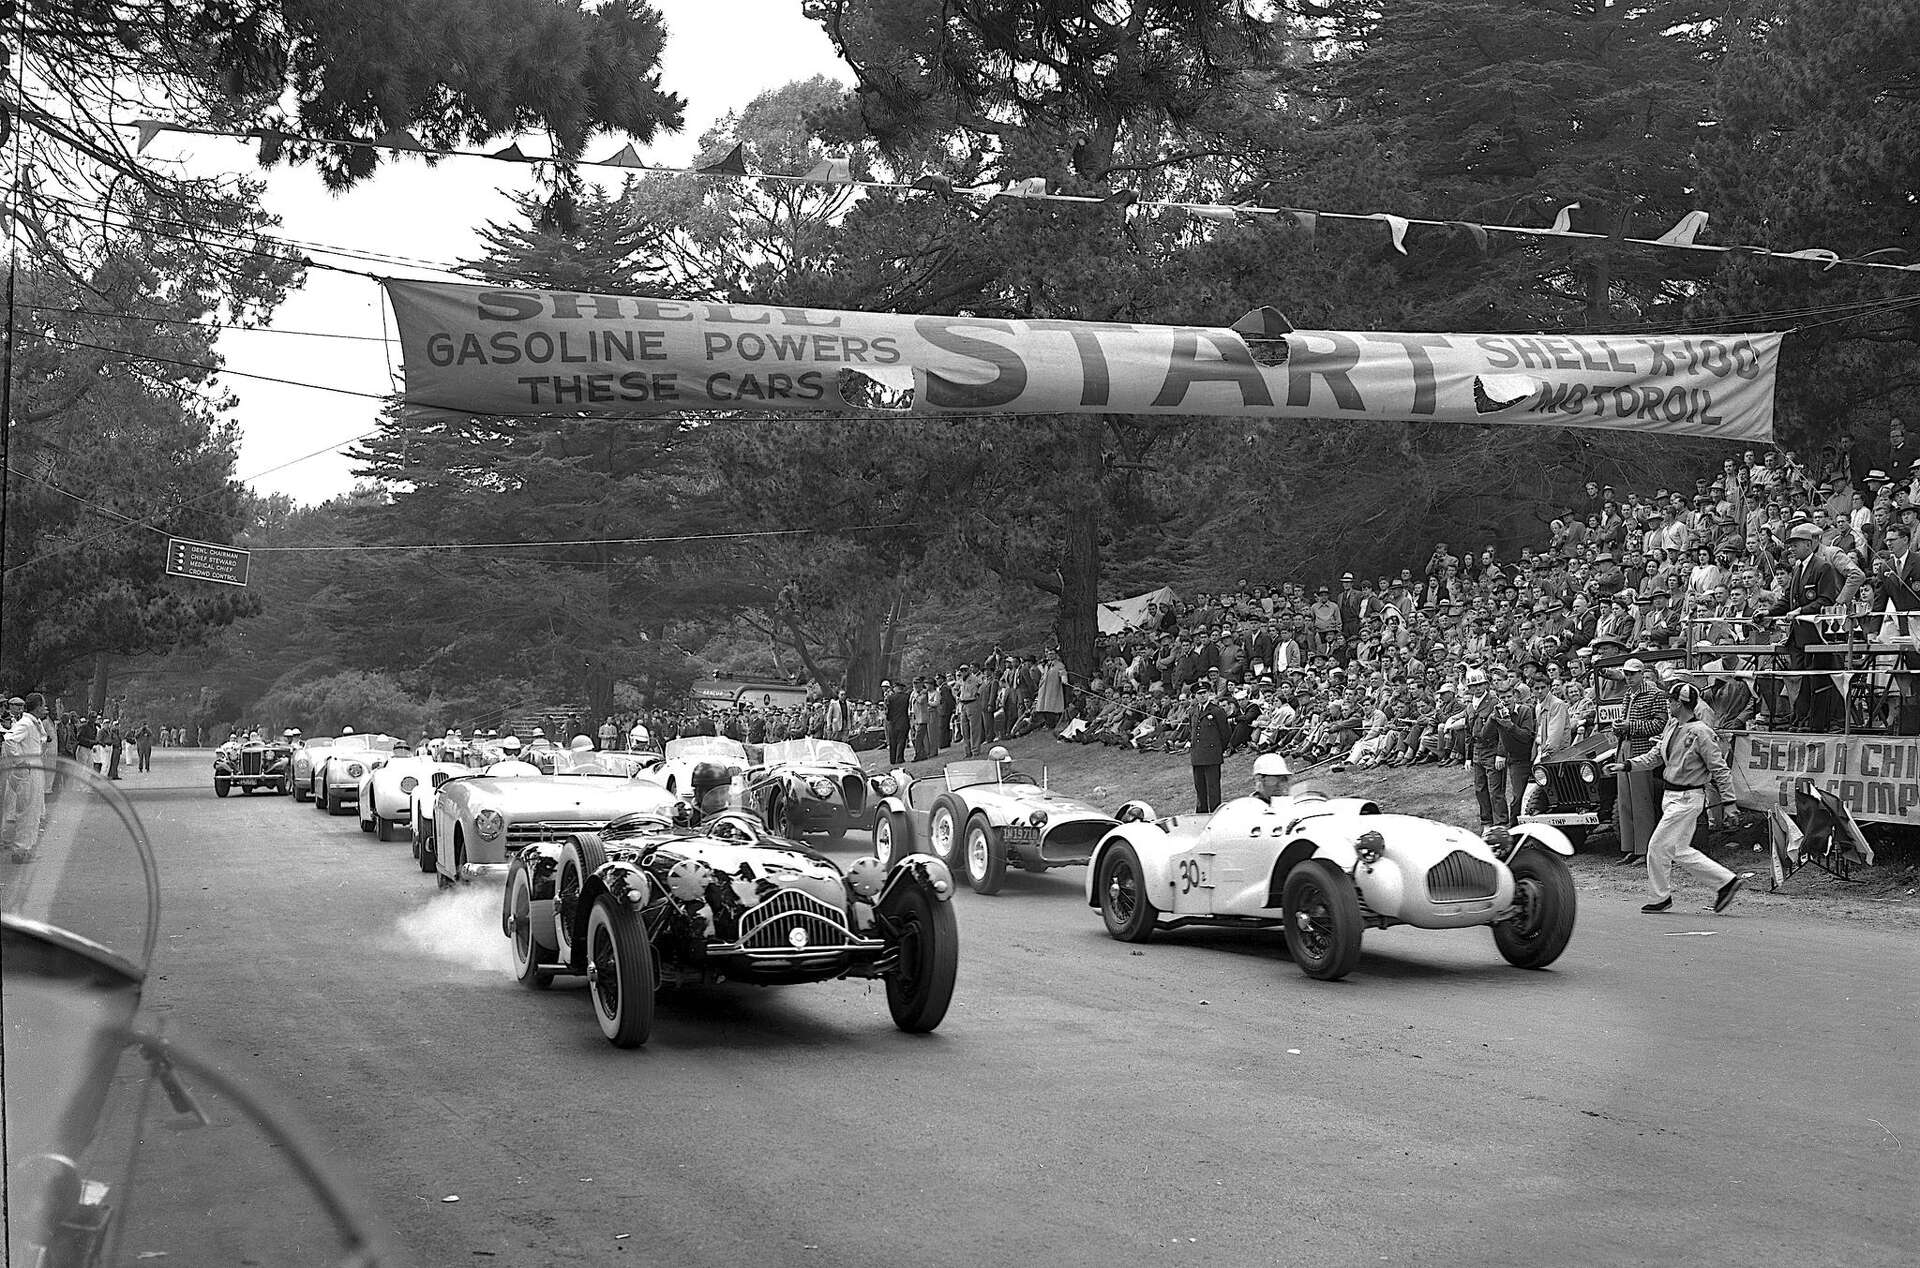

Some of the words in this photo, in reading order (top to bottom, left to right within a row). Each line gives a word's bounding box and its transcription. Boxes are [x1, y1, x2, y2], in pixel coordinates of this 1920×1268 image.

[478, 290, 841, 328] SHELL
[426, 330, 668, 367] GASOLINE
[705, 331, 902, 365] POWERS
[913, 316, 1453, 414] START
[1476, 337, 1636, 374] SHELL
[1636, 337, 1760, 380] X-100
[518, 371, 680, 405] THESE
[706, 372, 825, 402] CARS
[190, 561, 215, 569] MEDICAL
[209, 549, 239, 559] CHAIRMAN
[209, 557, 237, 566] STEWARD
[188, 568, 211, 577] CROWD
[212, 572, 238, 581] CONTROL
[1749, 739, 1825, 773] SEND
[1833, 743, 1848, 775] A
[1776, 776, 1815, 807] TO
[1179, 859, 1200, 895] 30
